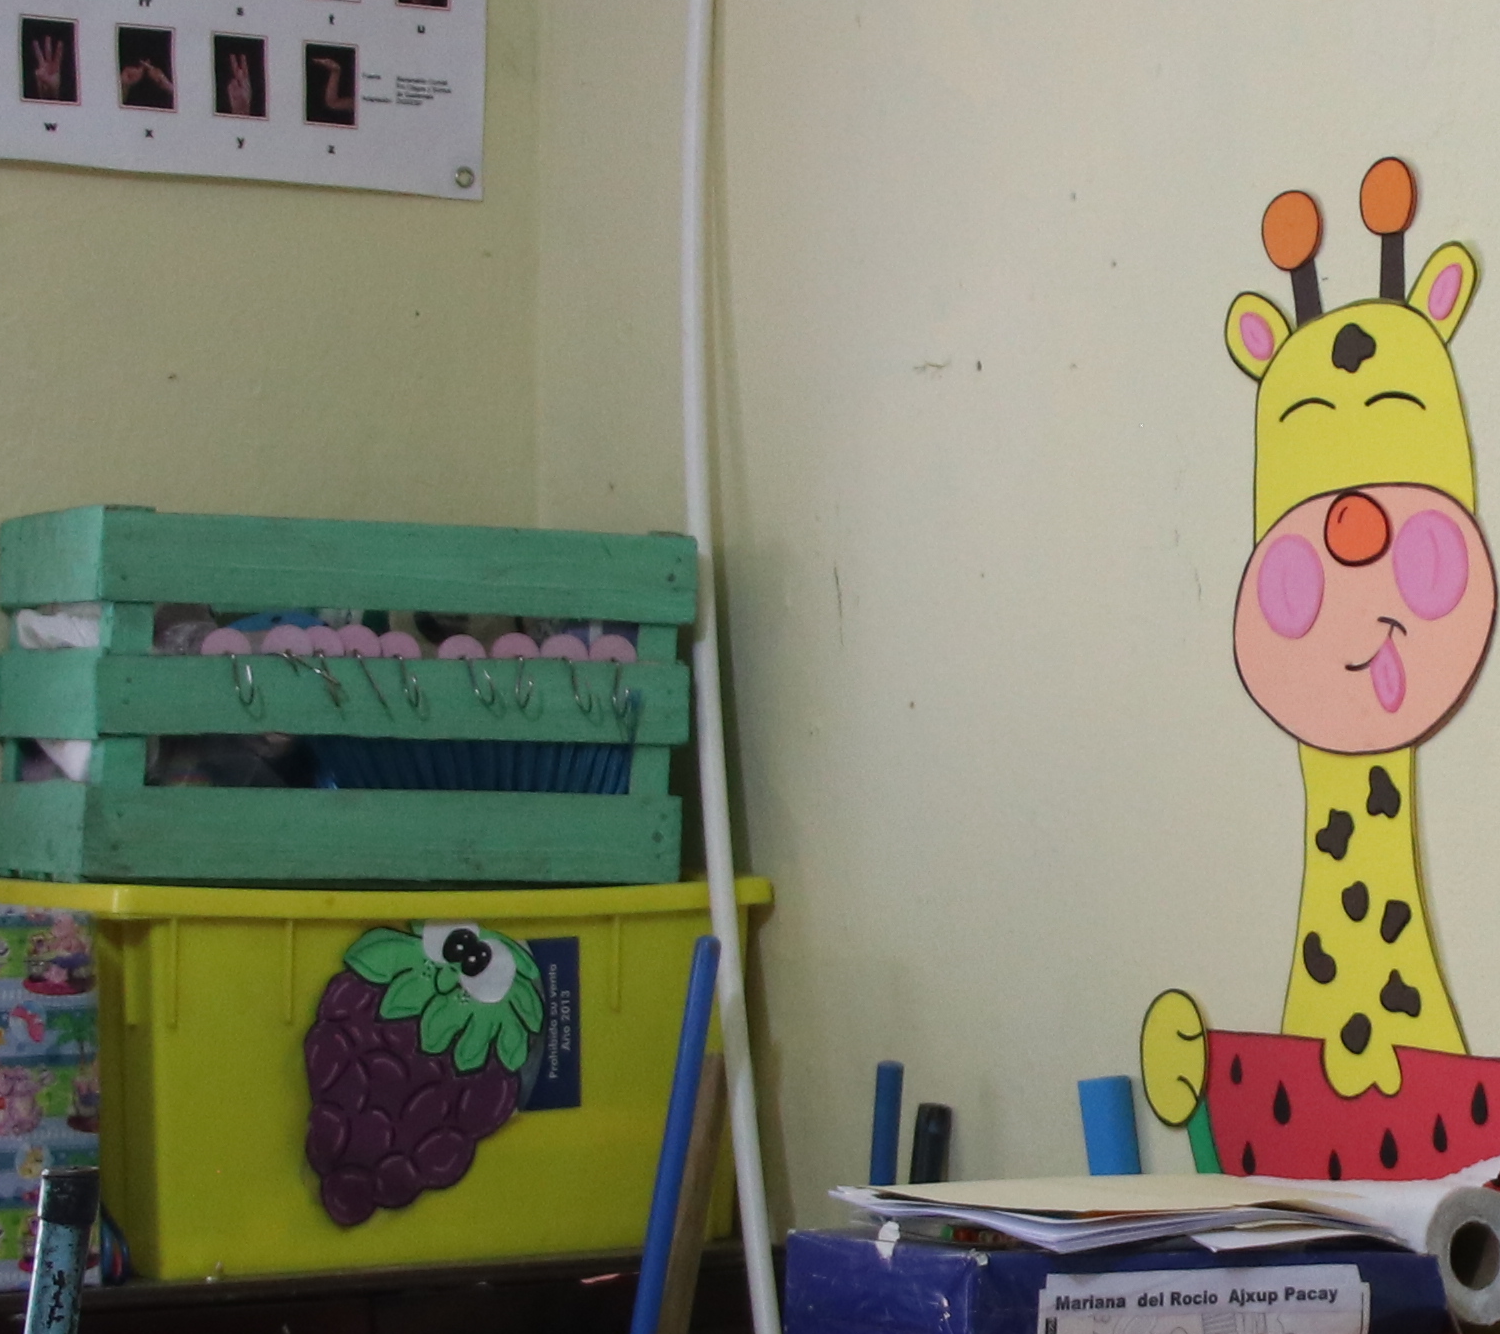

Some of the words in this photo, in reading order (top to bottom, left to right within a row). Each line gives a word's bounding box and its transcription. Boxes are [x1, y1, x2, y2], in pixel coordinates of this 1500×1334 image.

[329, 15, 334, 25] t
[417, 25, 425, 34] u
[44, 123, 56, 131] w
[145, 129, 153, 138] x
[237, 138, 244, 149] y
[560, 990, 570, 1021] 2013
[548, 1020, 558, 1079] Prohibido
[1055, 1295, 1126, 1311] Mariana
[1138, 1293, 1163, 1307] del
[1229, 1289, 1278, 1307] Ajxup
[1285, 1287, 1337, 1303] Pacay
